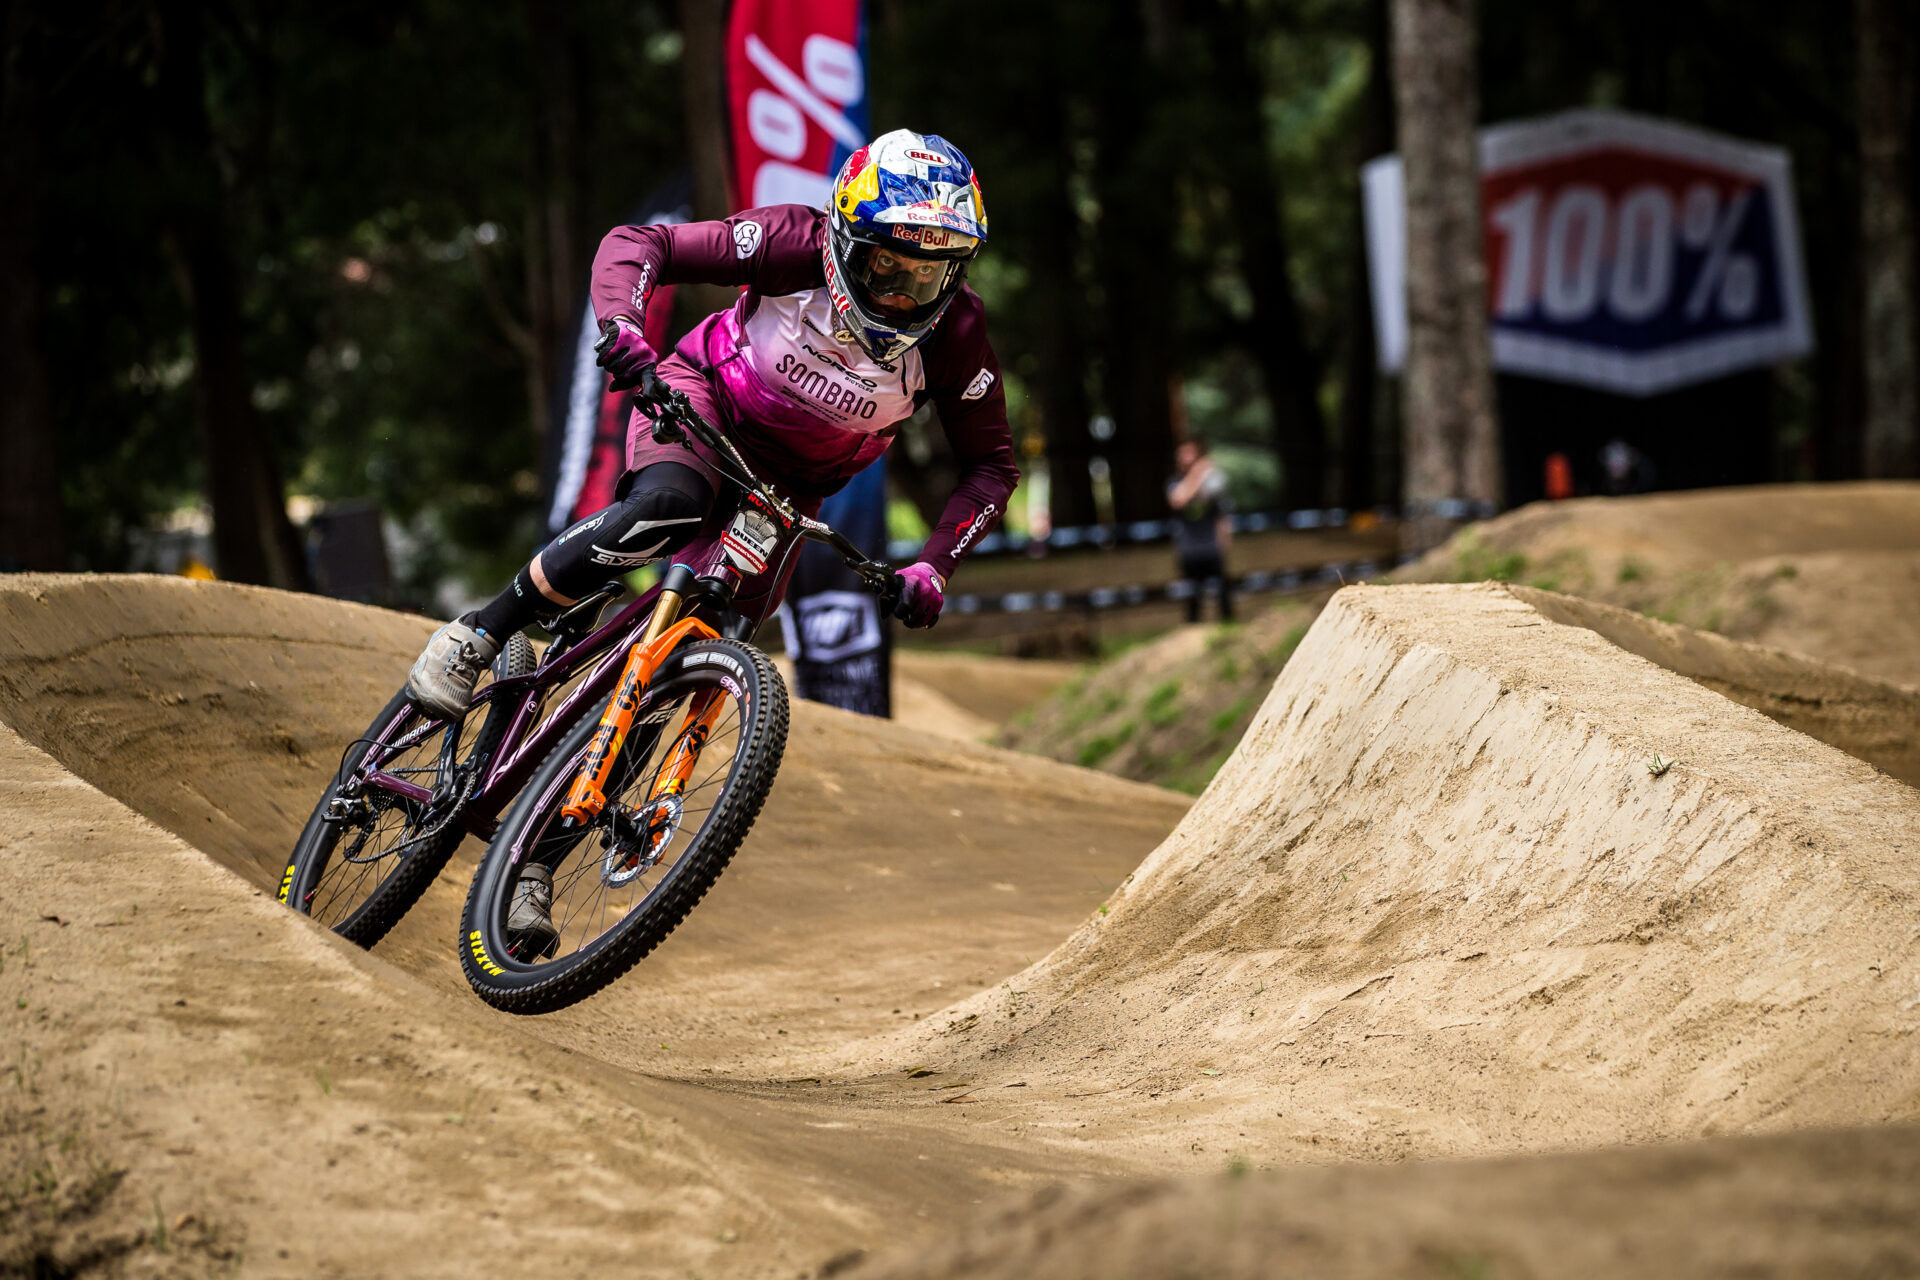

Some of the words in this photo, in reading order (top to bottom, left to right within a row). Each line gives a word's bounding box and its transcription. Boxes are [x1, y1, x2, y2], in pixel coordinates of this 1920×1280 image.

[910, 151, 945, 164] BELL
[892, 223, 924, 243] Red
[923, 230, 950, 247] Bull
[907, 212, 939, 222] Red
[940, 214, 969, 231] Bull
[842, 240, 855, 262] OAKLEY
[1490, 184, 1760, 322] 100%
[825, 260, 851, 316] Bull
[802, 344, 878, 388] NORCO
[844, 376, 875, 393] BICYCLES
[775, 353, 878, 419] SOMBRIO
[732, 527, 769, 558] QUEEN
[950, 503, 995, 559] NORCO
[723, 537, 764, 571] CRANKWORX
[577, 725, 619, 782] FOX
[469, 930, 506, 977] MAXXIS
